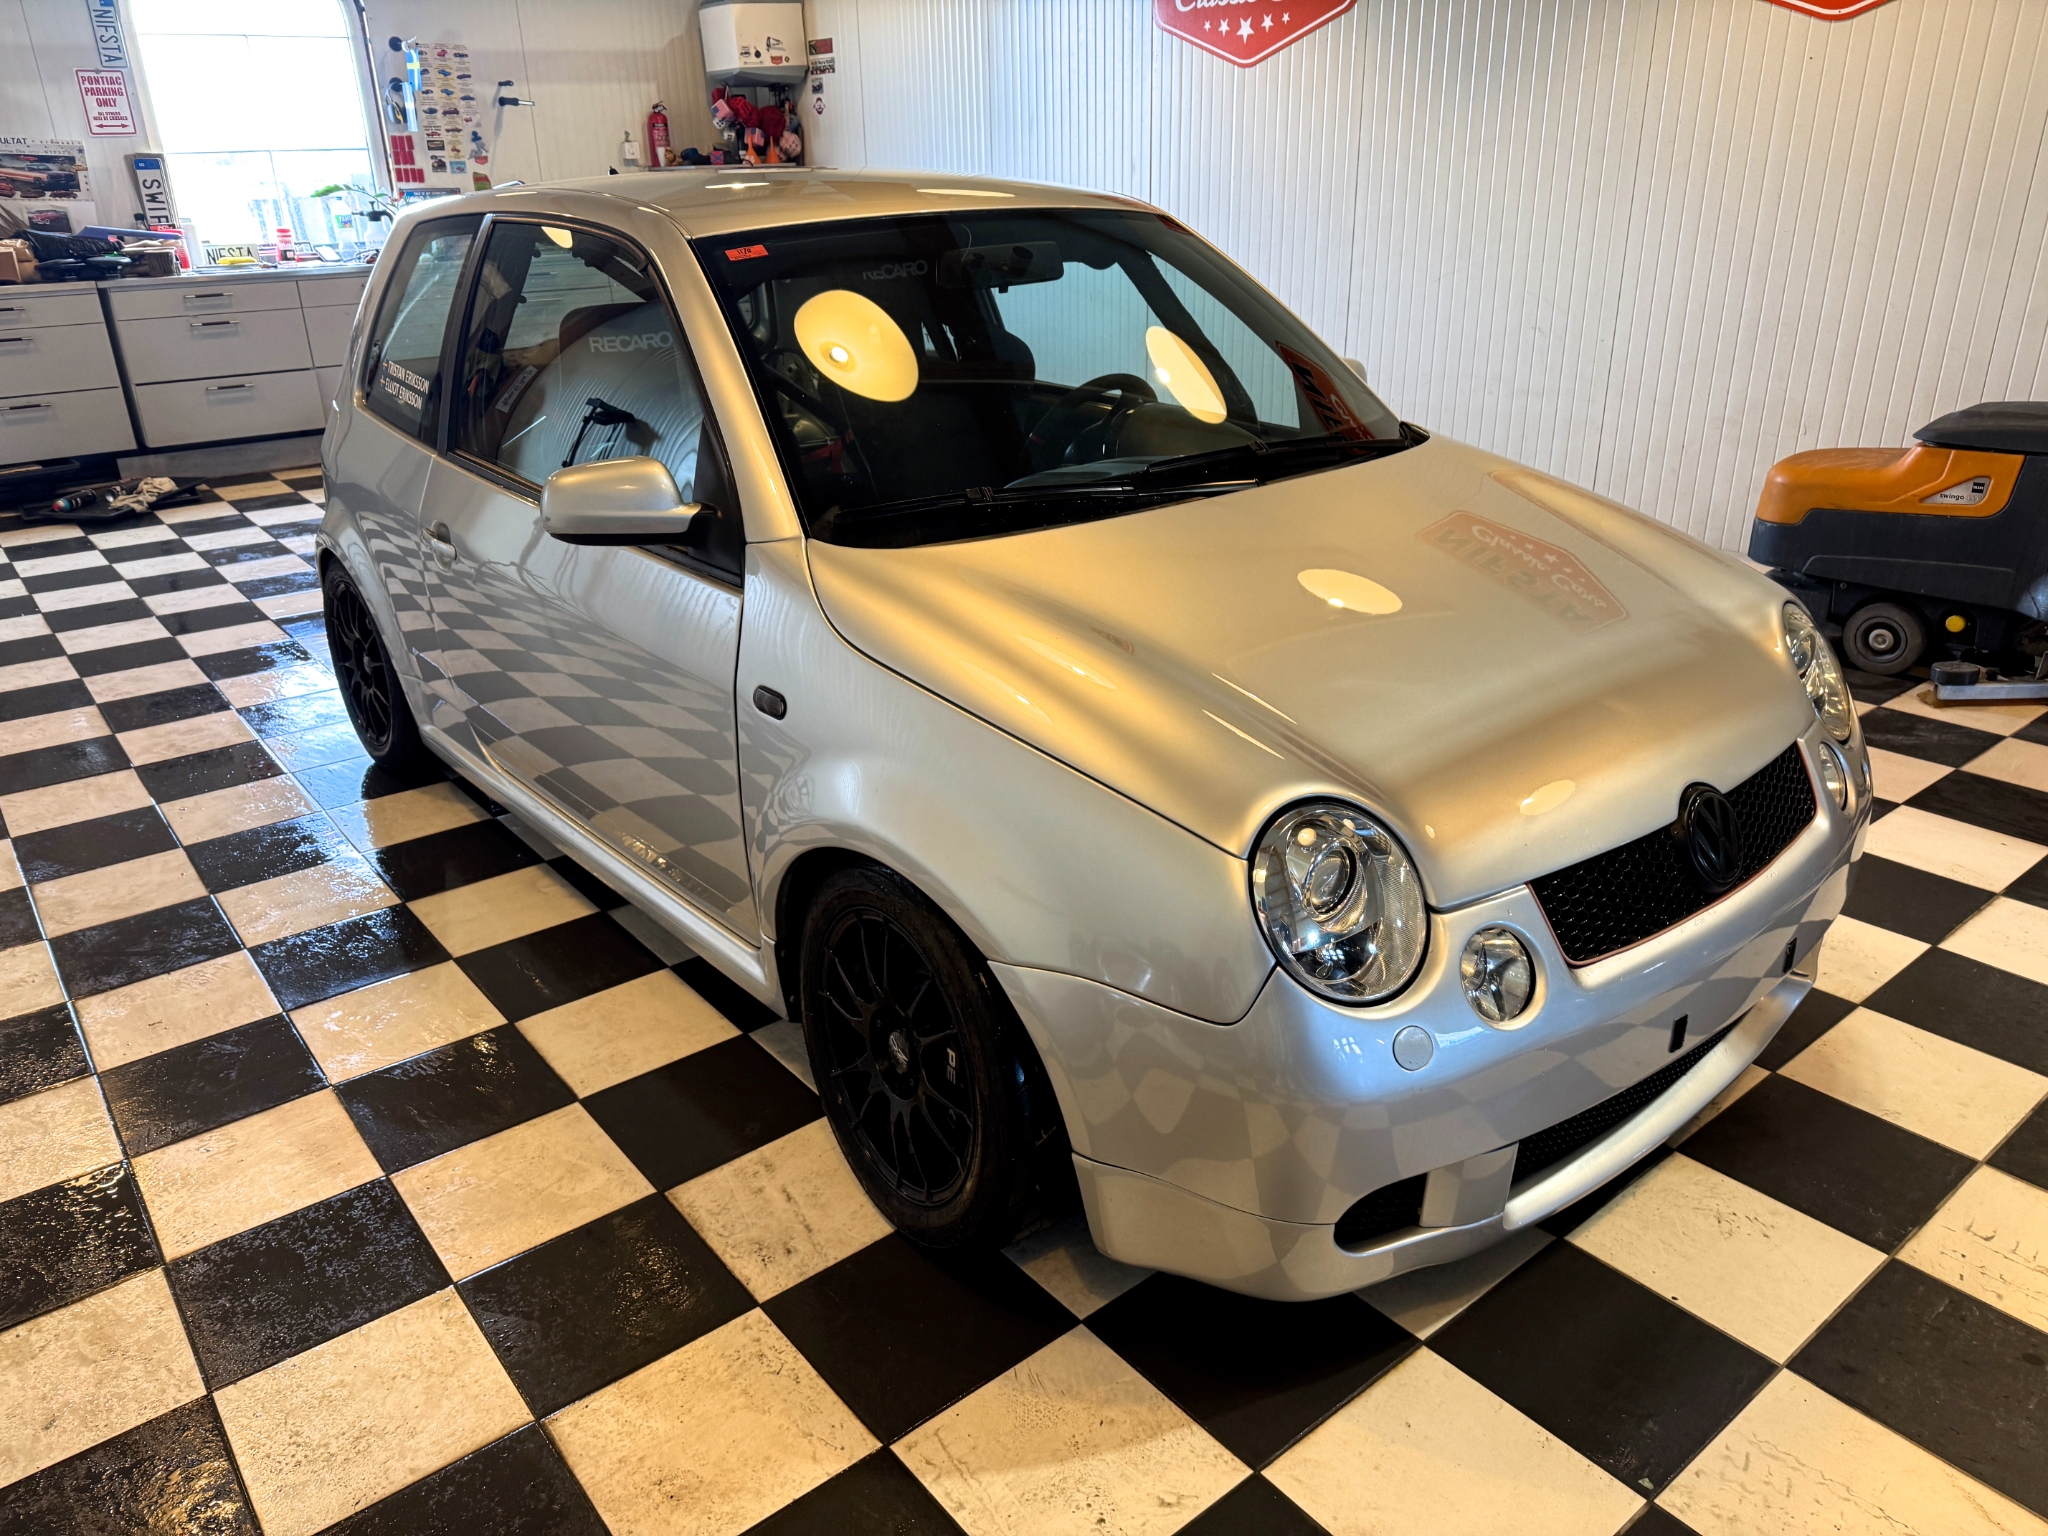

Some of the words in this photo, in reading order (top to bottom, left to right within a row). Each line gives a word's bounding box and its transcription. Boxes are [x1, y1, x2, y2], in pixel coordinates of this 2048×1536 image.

[92, 9, 123, 62] NIFSTA
[80, 76, 122, 86] PONTIAC
[84, 87, 124, 96] PARKING
[95, 97, 117, 107] ONLY
[588, 331, 674, 353] RECARO
[388, 360, 406, 381] TRISTAN
[405, 369, 430, 394] ERIKSSON
[385, 377, 400, 396] ELLIOT
[399, 385, 423, 410] ERIKSSON
[1939, 493, 1965, 501] swingo
